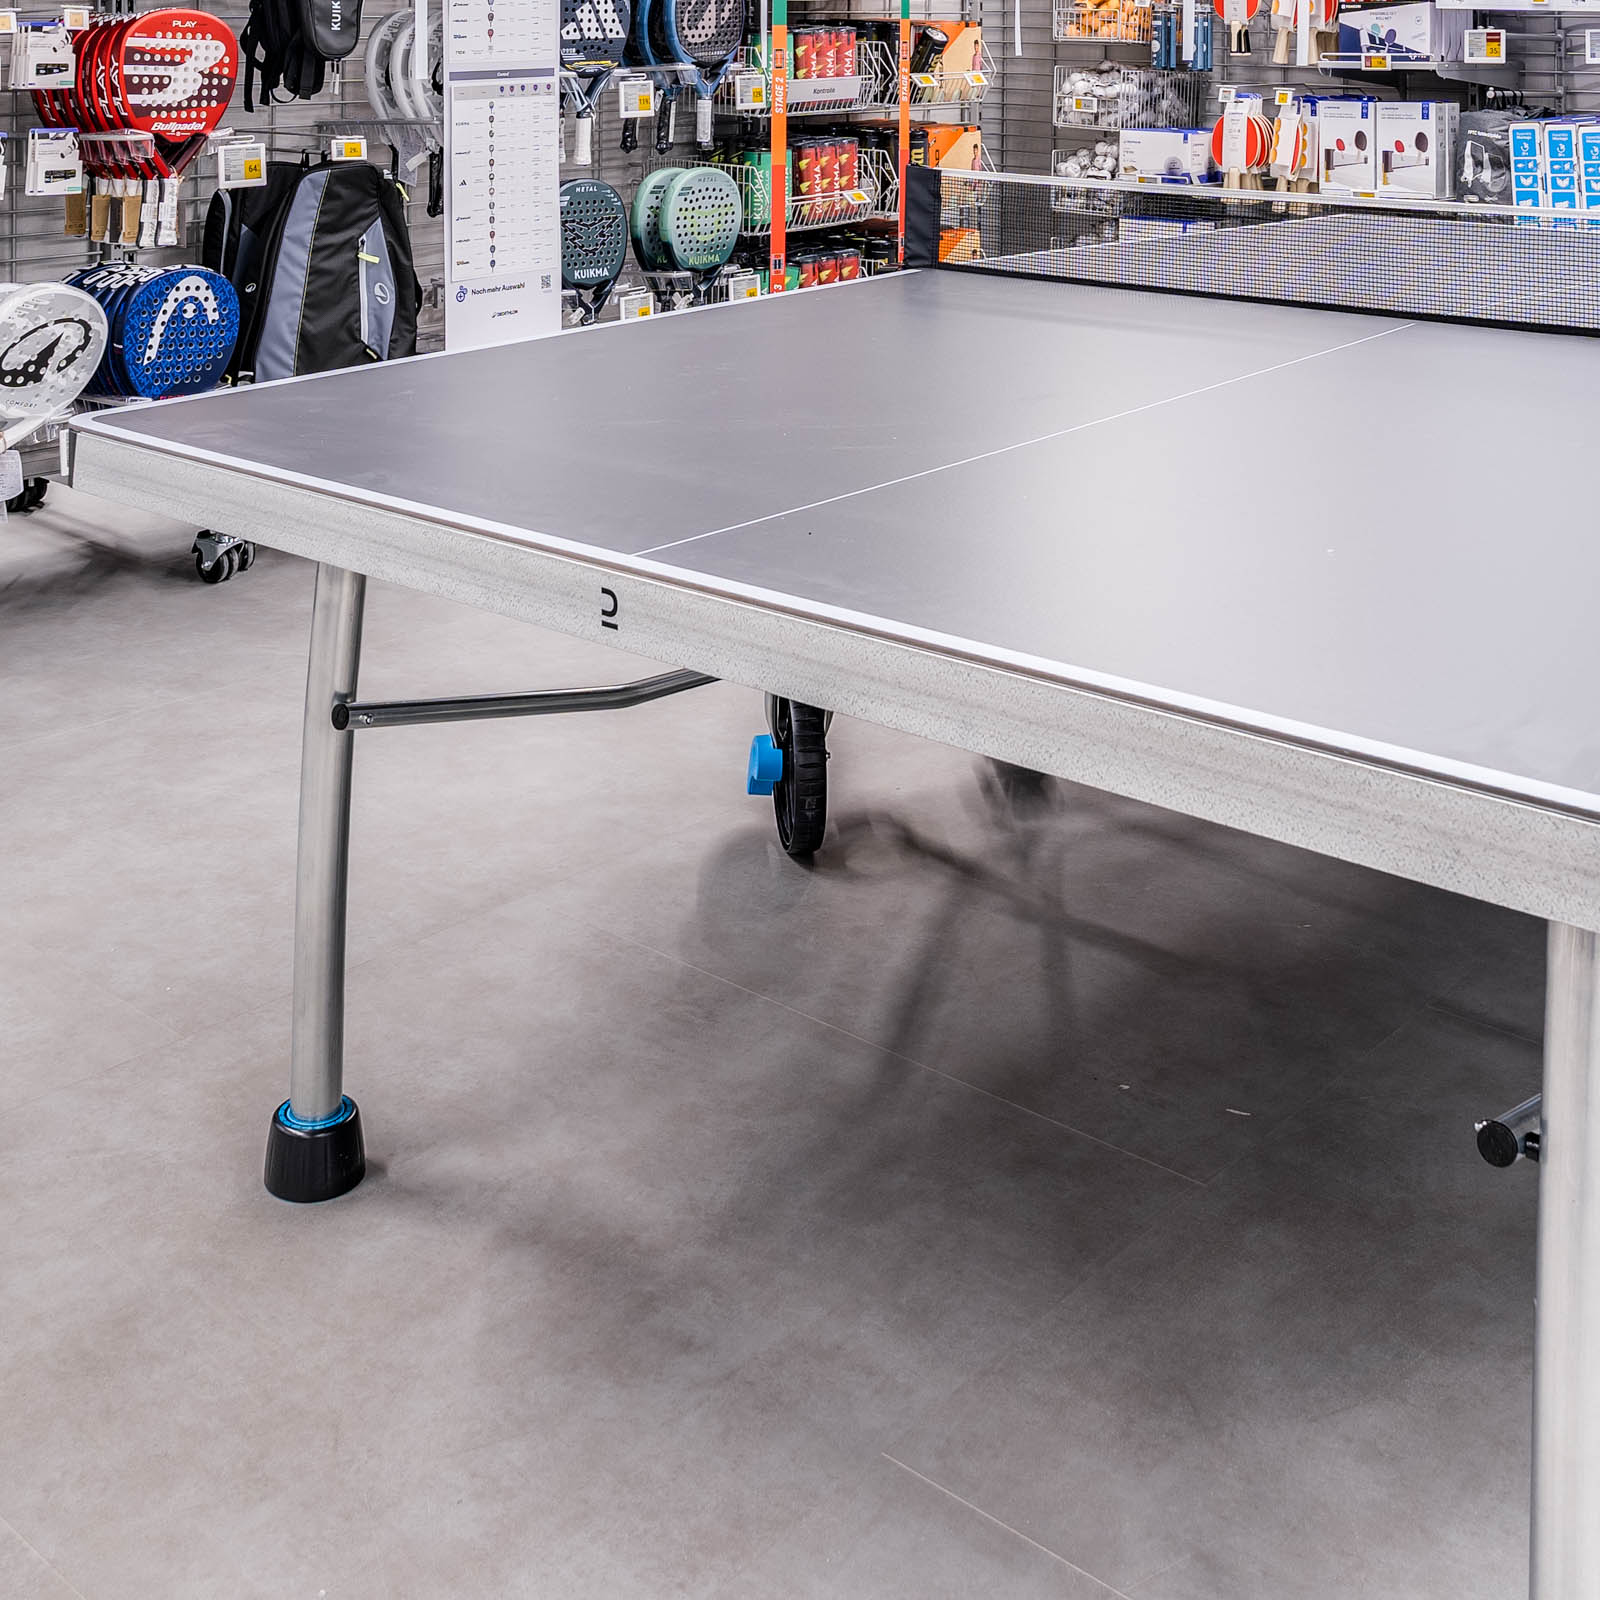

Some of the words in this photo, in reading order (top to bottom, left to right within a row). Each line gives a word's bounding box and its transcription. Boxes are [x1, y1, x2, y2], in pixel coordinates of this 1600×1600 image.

[902, 67, 909, 75] 2
[775, 76, 784, 86] 2
[775, 86, 784, 114] STAGE
[151, 122, 206, 133] Bullpadel
[689, 254, 720, 266] KUIKMA
[574, 266, 609, 279] KUIKMA
[472, 288, 486, 296] Noch
[487, 286, 500, 294] mehr
[502, 282, 525, 292] Auswahl
